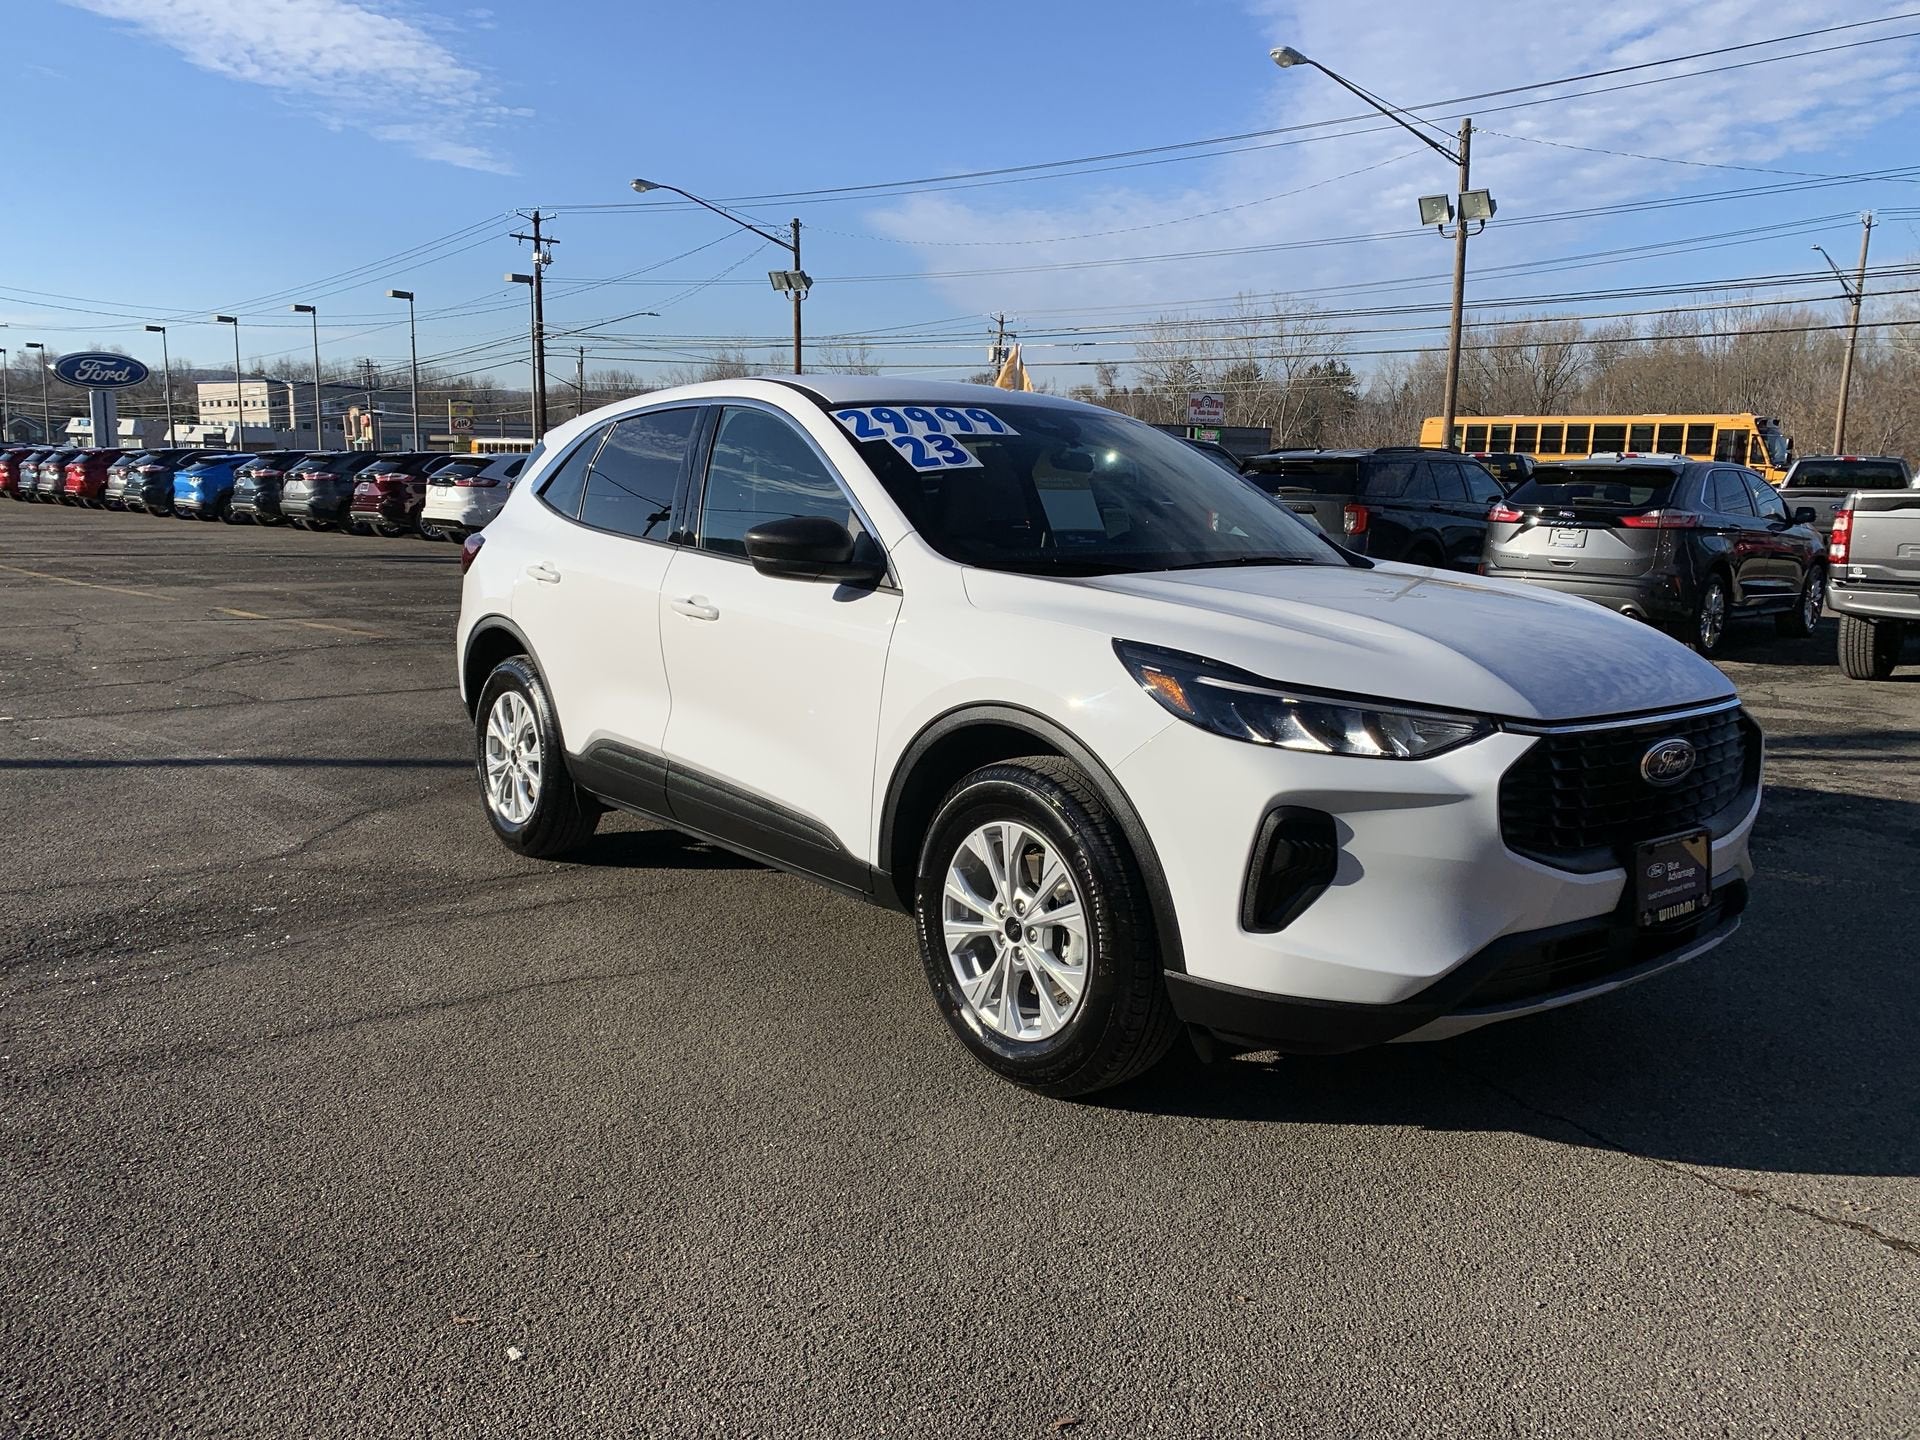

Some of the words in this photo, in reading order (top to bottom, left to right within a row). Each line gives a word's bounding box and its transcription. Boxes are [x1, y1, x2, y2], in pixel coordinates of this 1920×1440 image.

[75, 360, 130, 382] Ford
[836, 407, 1006, 438] 29999
[891, 434, 969, 467] 23
[1657, 749, 1690, 775] Ford
[1658, 899, 1696, 922] WILLIAMS
